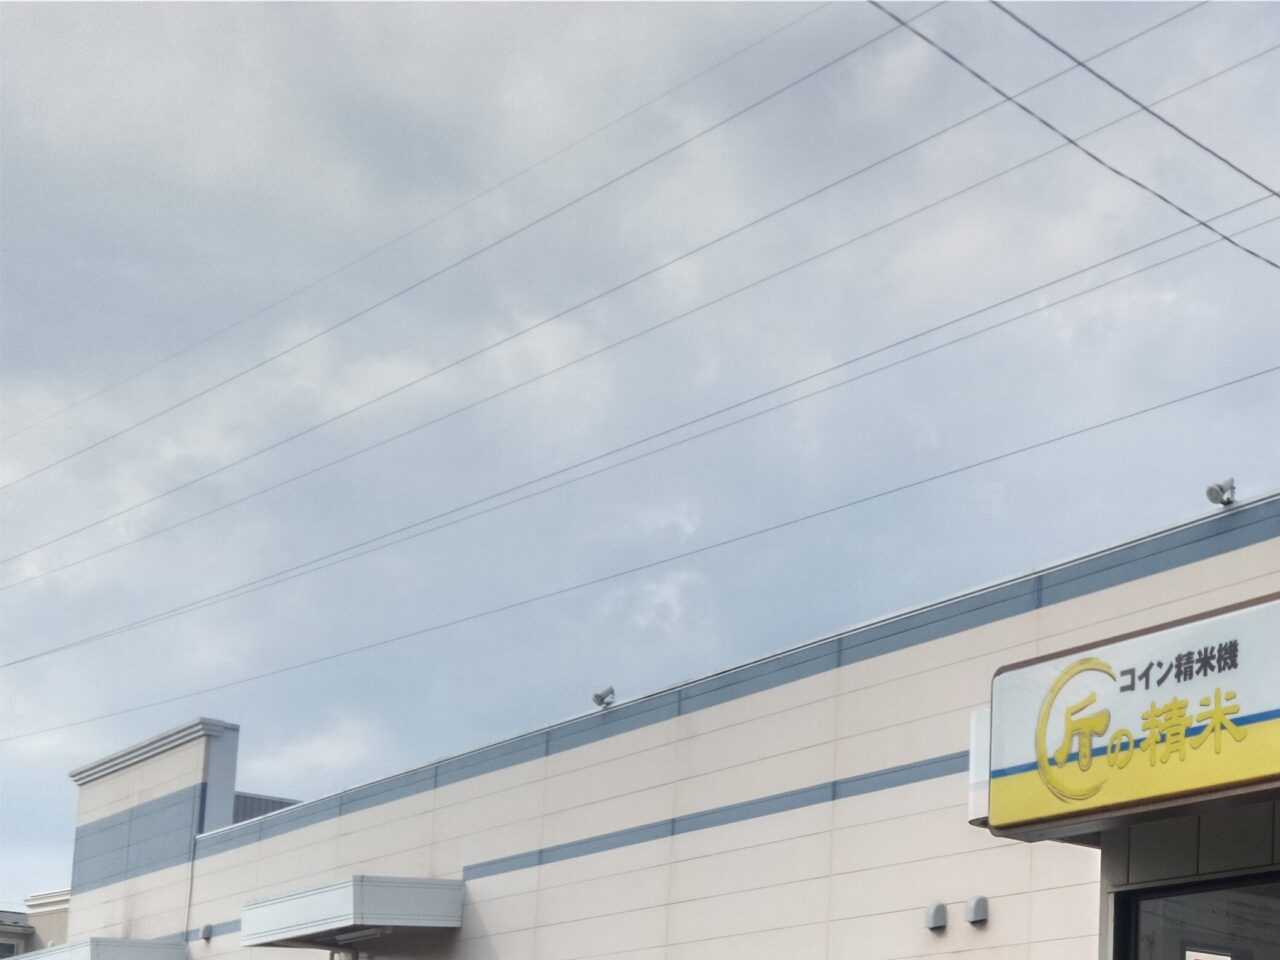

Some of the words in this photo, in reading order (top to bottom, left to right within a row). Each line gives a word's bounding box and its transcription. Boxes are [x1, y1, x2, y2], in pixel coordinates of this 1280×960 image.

[1119, 639, 1239, 693] コイン精米機
